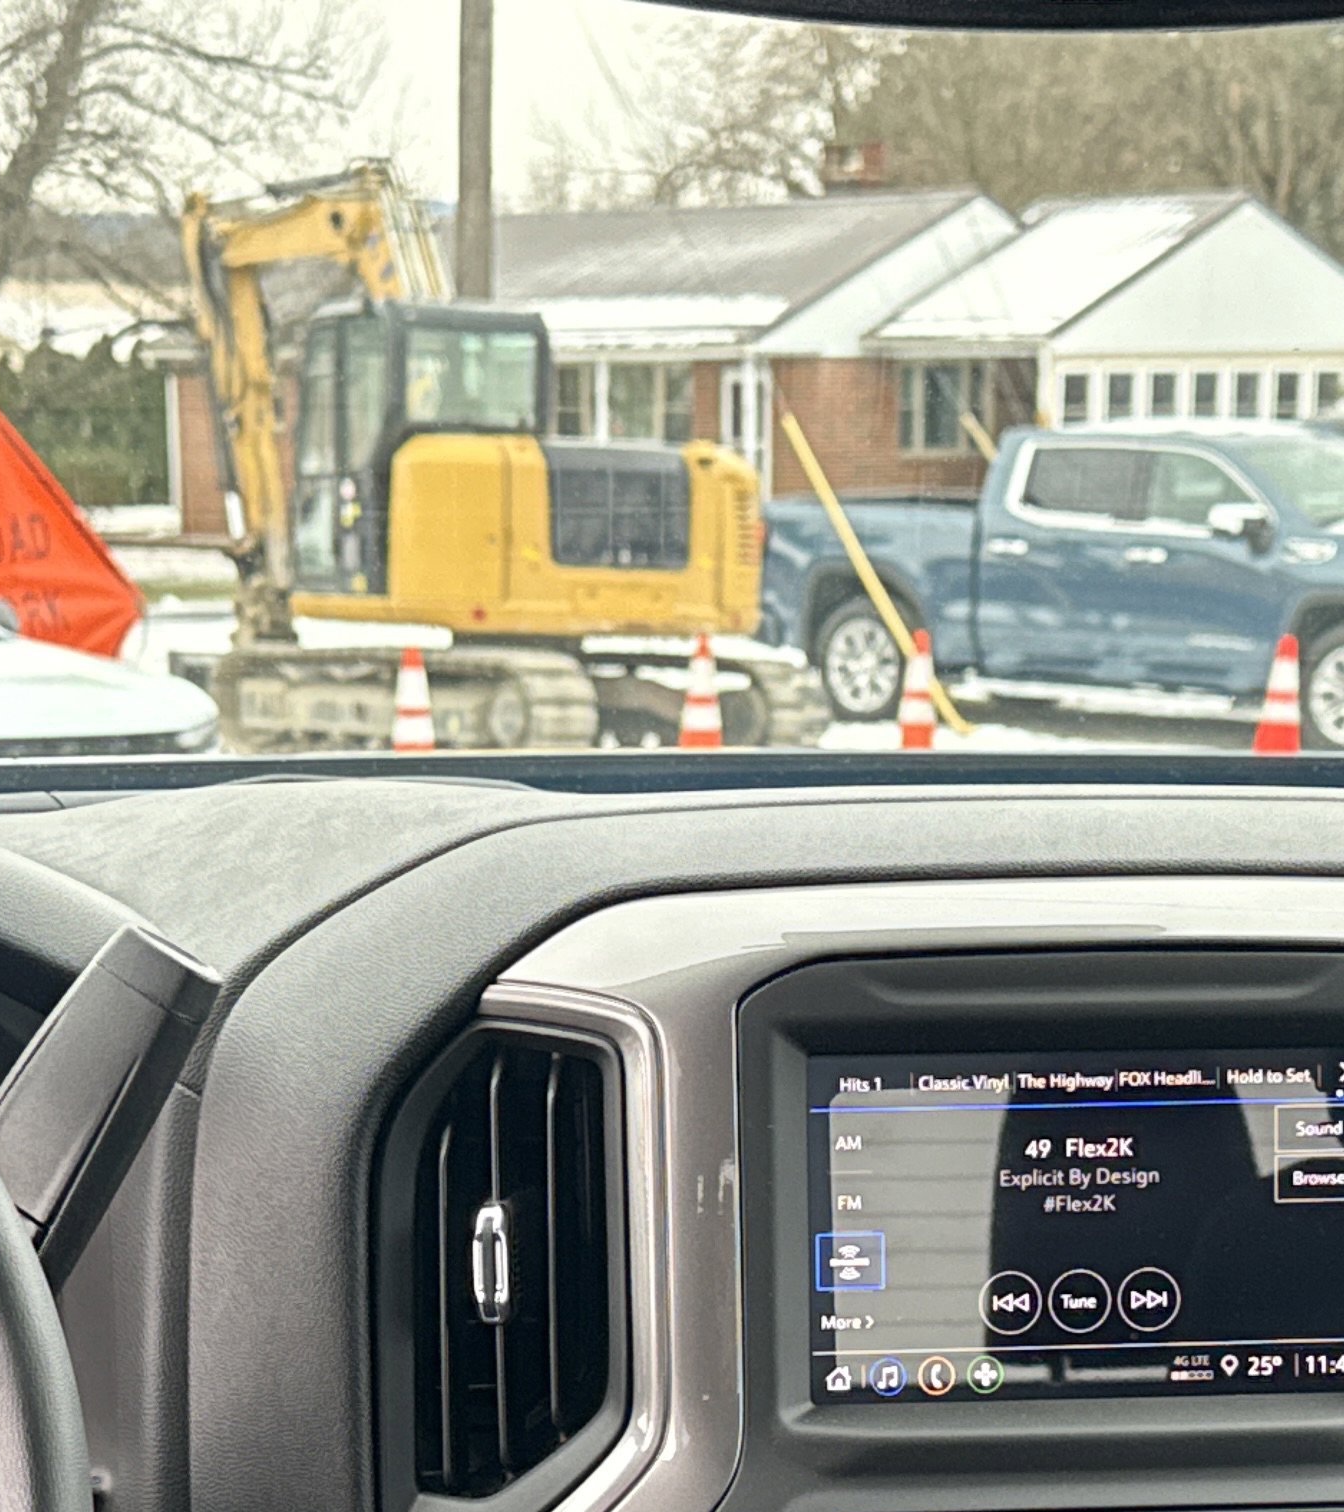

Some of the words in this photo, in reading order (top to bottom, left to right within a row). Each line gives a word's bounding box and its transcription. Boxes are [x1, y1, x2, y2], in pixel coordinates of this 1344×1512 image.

[918, 1075, 968, 1091] Classic
[972, 1074, 1009, 1094] Vinyl
[1017, 1073, 1045, 1089] The
[1050, 1072, 1114, 1093] Highway
[1119, 1070, 1150, 1087] FOX
[1227, 1069, 1261, 1084] Hold
[1267, 1070, 1282, 1083] to
[1286, 1067, 1310, 1084] Set
[839, 1078, 869, 1092] Hits
[1296, 1119, 1344, 1137] Sound
[835, 1136, 862, 1151] AM
[1025, 1140, 1051, 1157] 49
[1066, 1137, 1134, 1156] Flex2K
[1000, 1169, 1064, 1189] Explicit
[1069, 1169, 1091, 1187] By
[1096, 1166, 1160, 1187] Design
[837, 1196, 862, 1211] FM
[1043, 1194, 1116, 1212] #Flex2K
[1061, 1293, 1097, 1309] Tune
[821, 1314, 862, 1331] More
[1173, 1355, 1189, 1366] 4G
[1192, 1354, 1210, 1366] LTE
